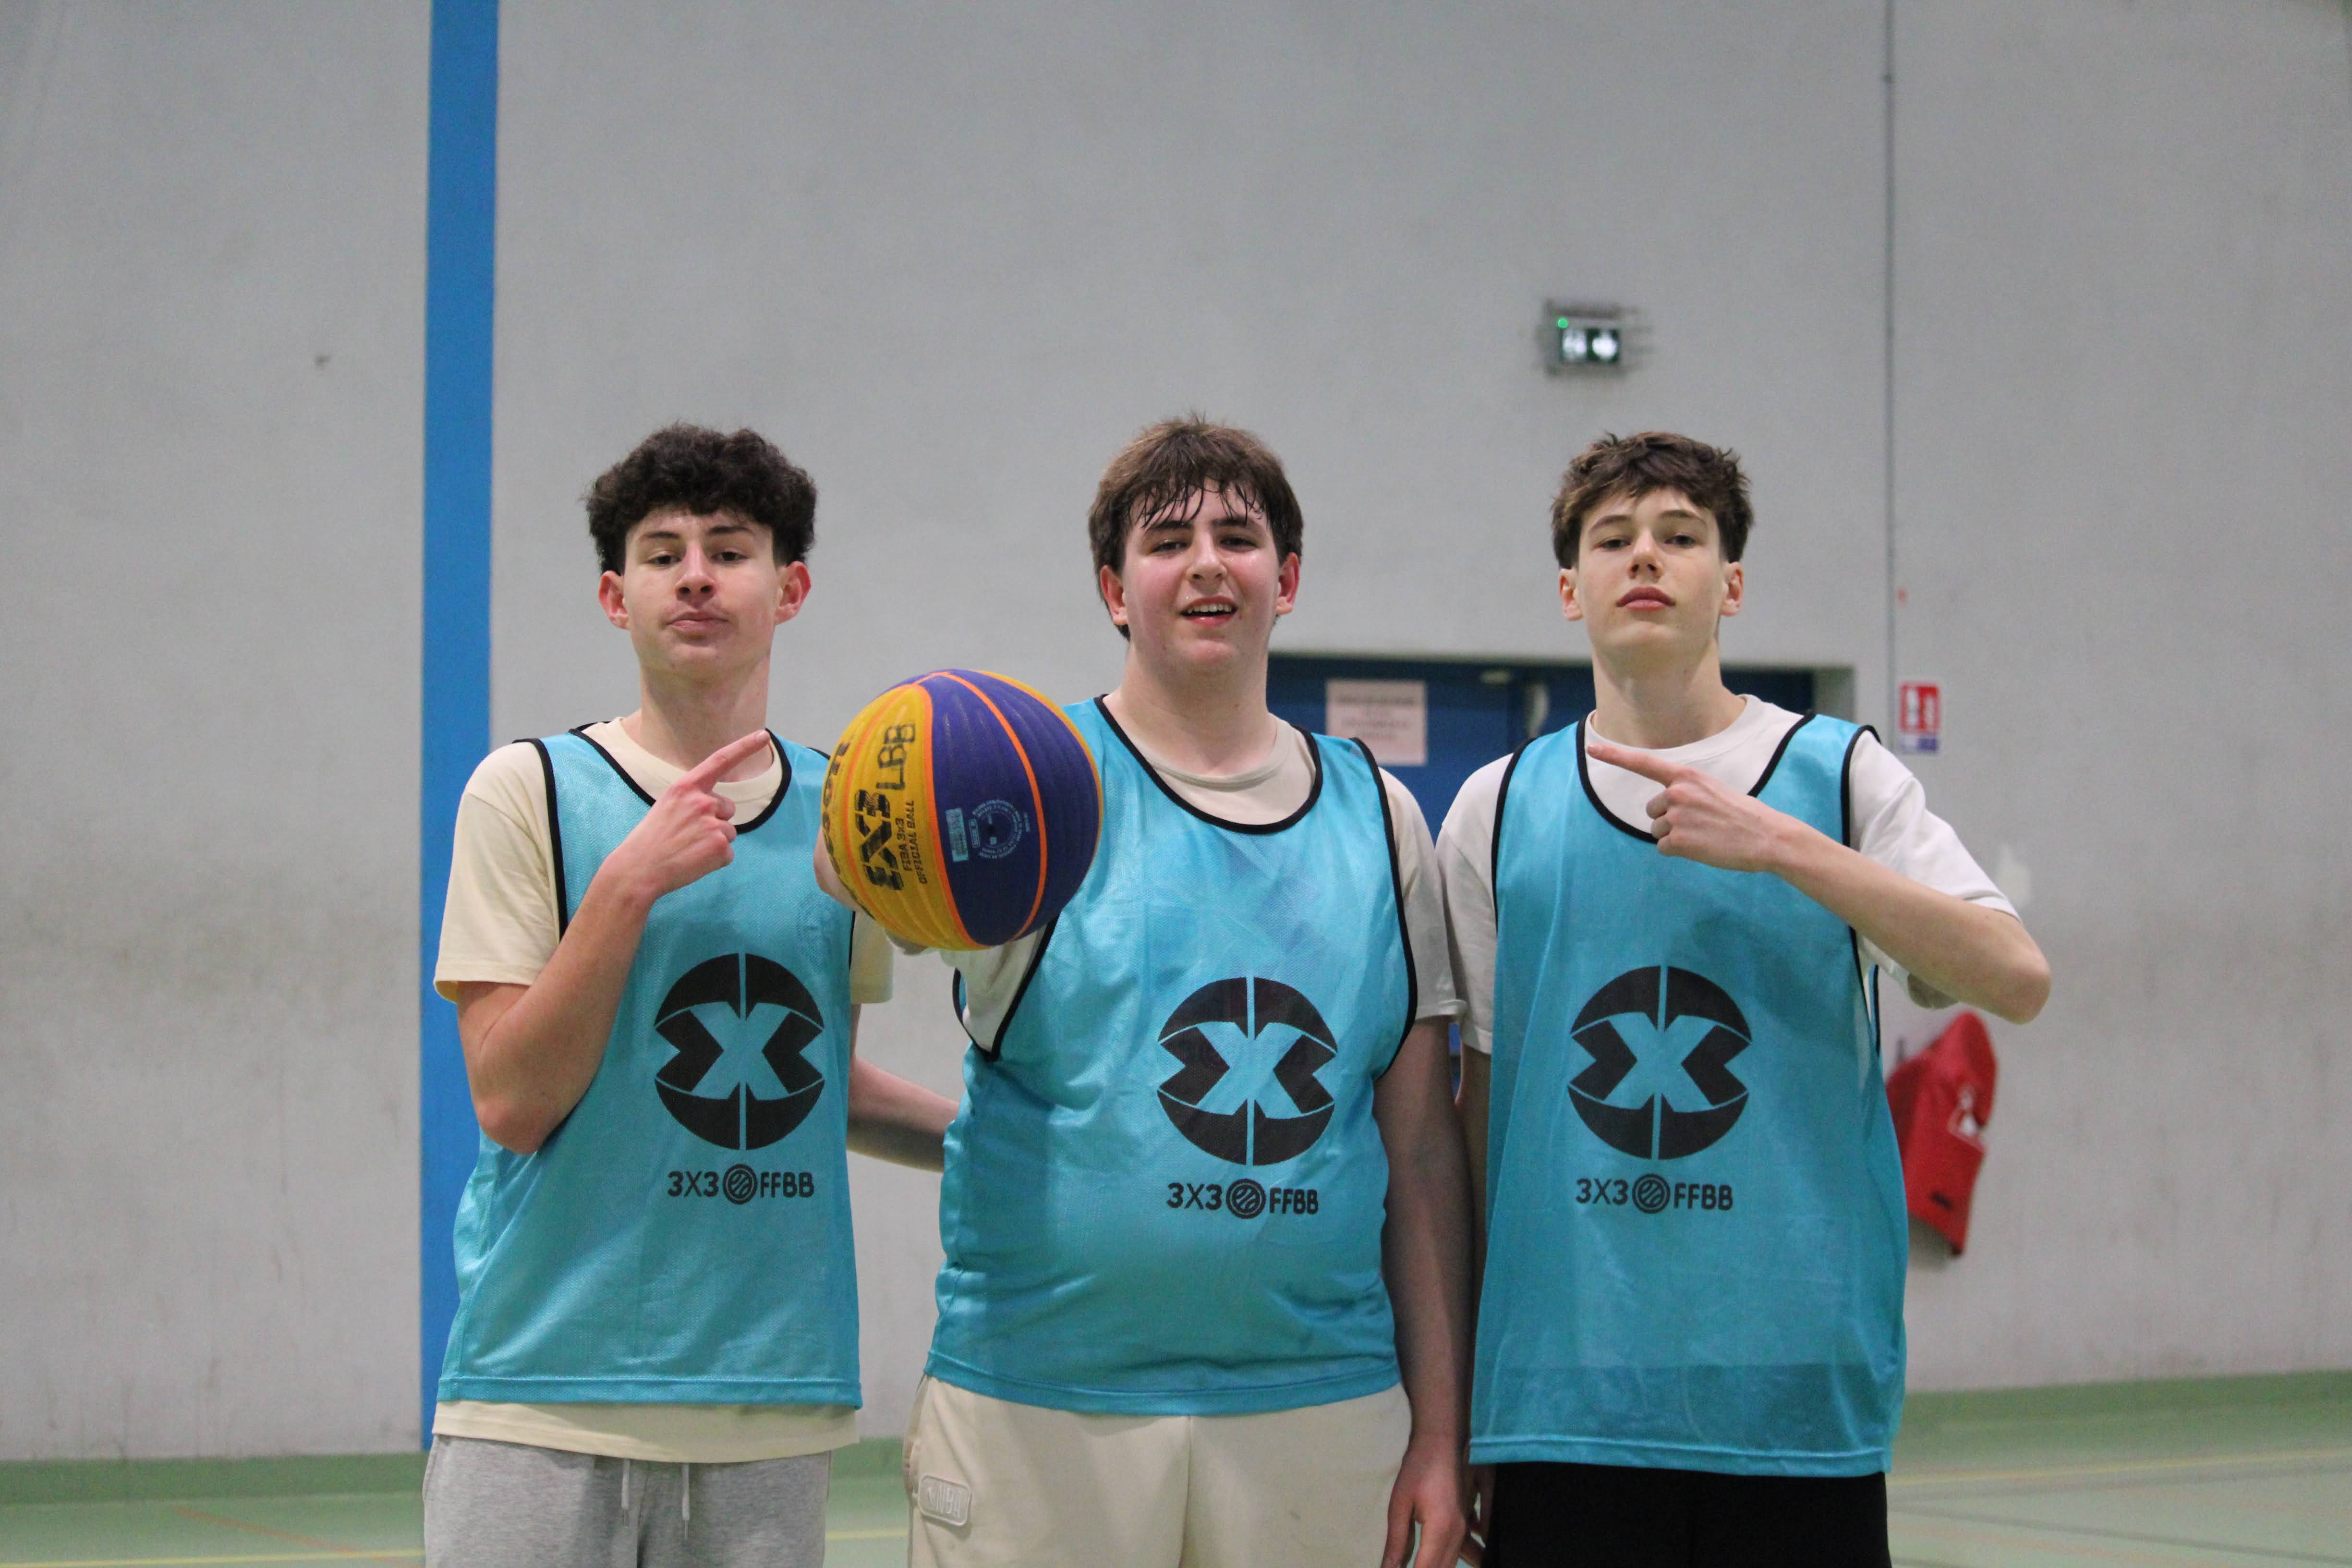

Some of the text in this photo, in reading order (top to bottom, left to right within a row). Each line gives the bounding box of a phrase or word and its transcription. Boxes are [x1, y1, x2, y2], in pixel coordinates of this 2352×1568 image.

[906, 801, 927, 884] OFFICIAL BALL
[667, 1171, 814, 1198] 3X3 FFBB
[1166, 1182, 1319, 1215] 3X3 FFBB
[1576, 1178, 1733, 1211] 3X3 FFBB
